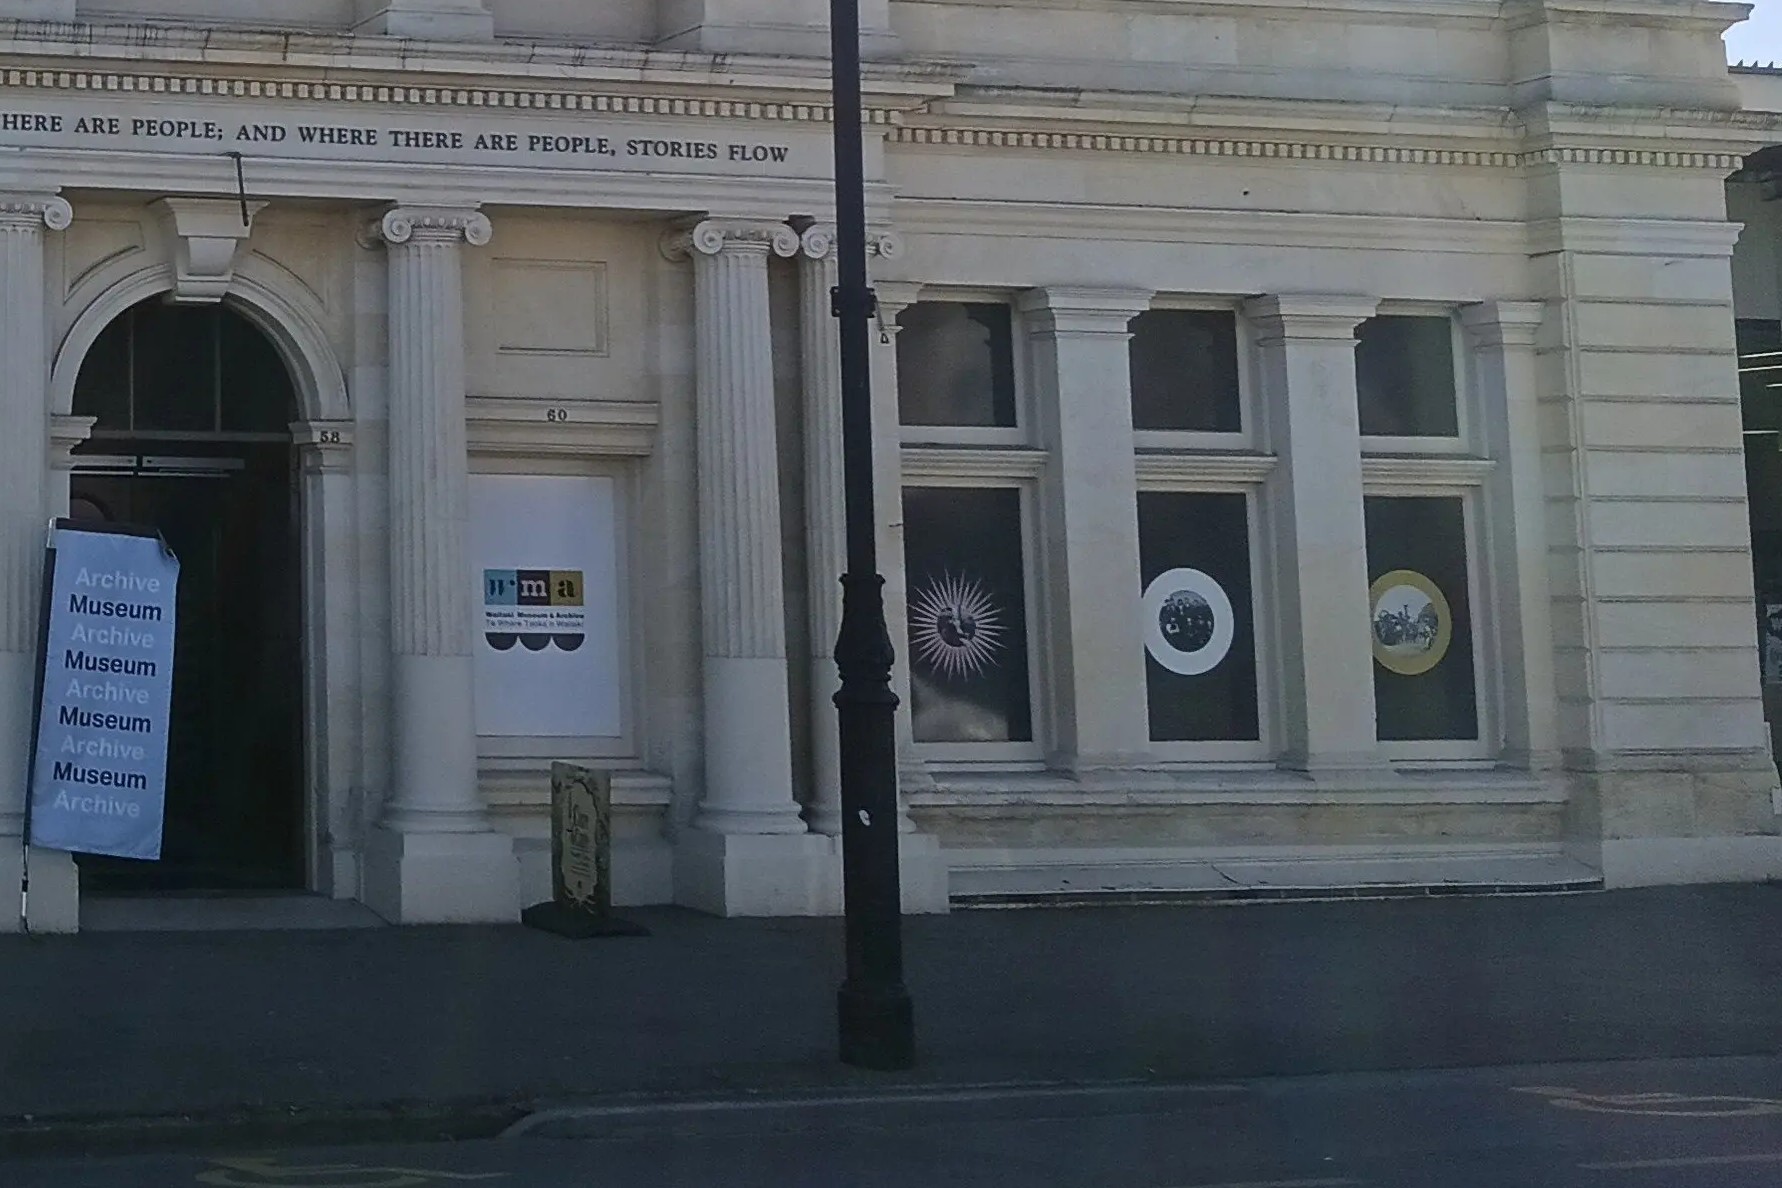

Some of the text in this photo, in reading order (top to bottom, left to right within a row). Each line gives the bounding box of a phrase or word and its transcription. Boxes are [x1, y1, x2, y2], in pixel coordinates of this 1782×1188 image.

[74, 116, 121, 135] ARE
[131, 119, 223, 141] PEOPLE;
[235, 124, 287, 142] AND
[298, 126, 378, 146] WHERE
[389, 130, 464, 150] THERE
[473, 133, 518, 152] ARE
[528, 135, 617, 156] PEOPLE,
[626, 139, 719, 159] STORIES
[728, 144, 789, 163] FLOW
[547, 408, 568, 422] 60
[320, 430, 340, 443] 58
[75, 567, 161, 593] Archive
[69, 593, 162, 621] Museum
[71, 623, 155, 648] Archive
[64, 649, 156, 677] Museum
[66, 679, 149, 704] Archive
[59, 705, 151, 733] Museum
[61, 734, 145, 760] Archive
[53, 761, 147, 789] Museum
[54, 791, 140, 817] Archive
